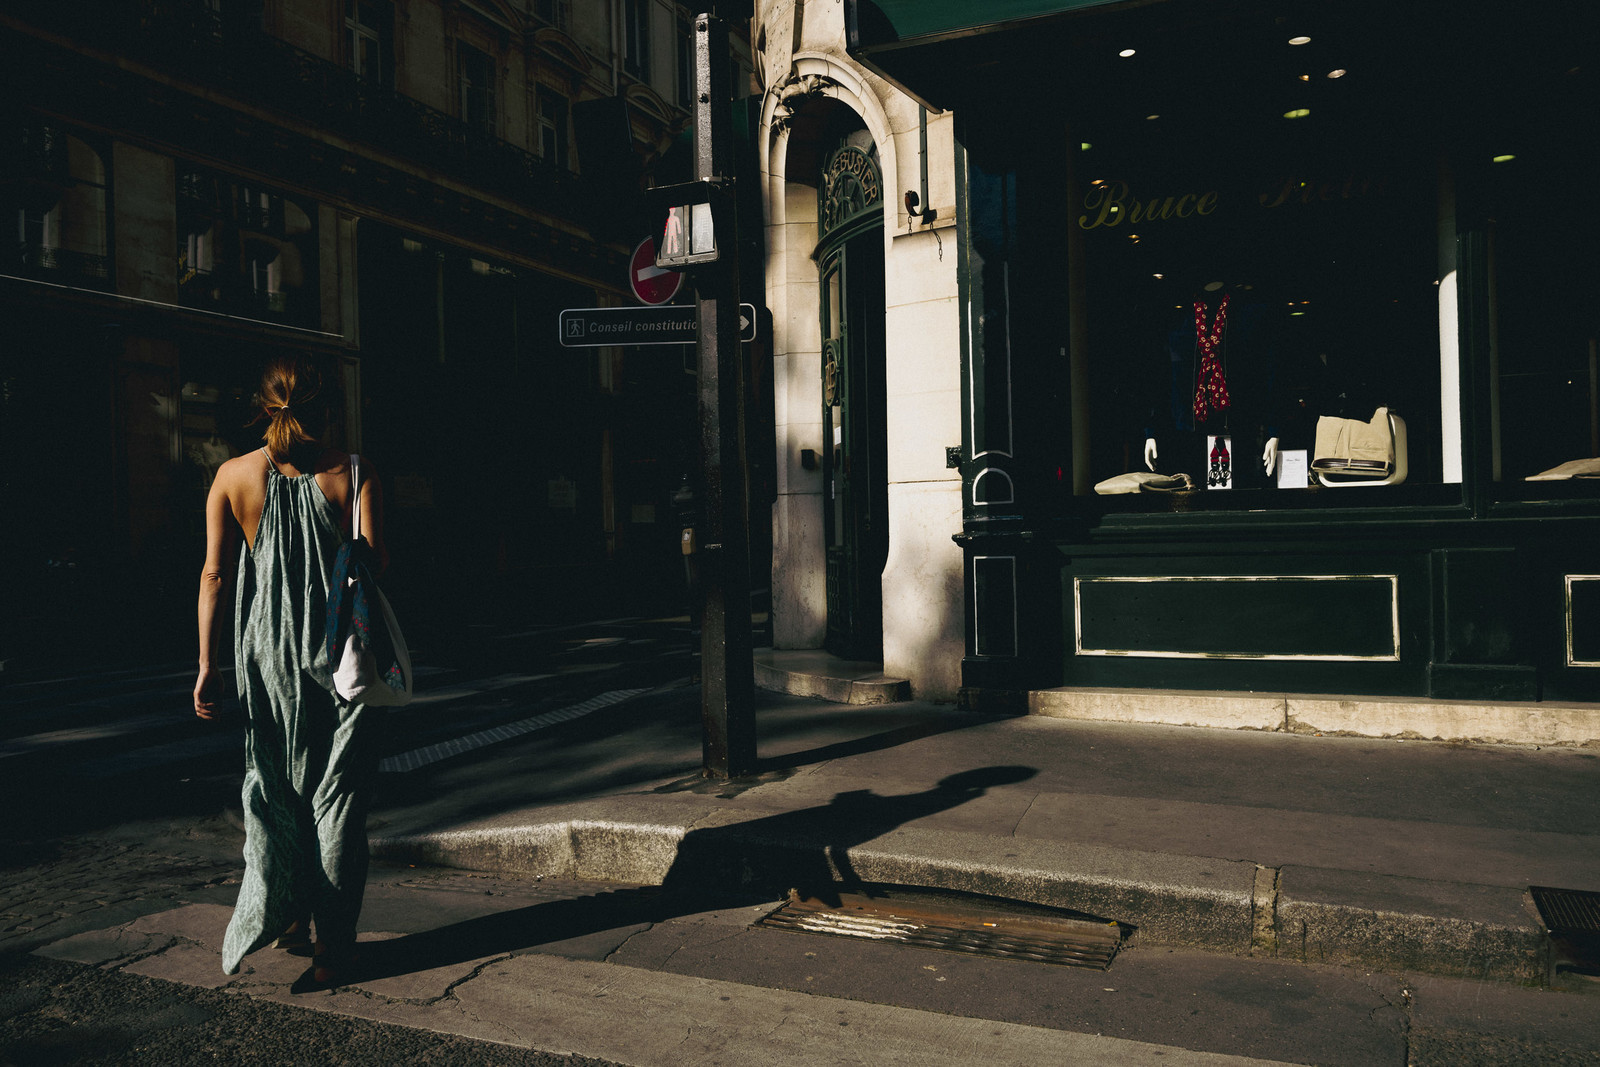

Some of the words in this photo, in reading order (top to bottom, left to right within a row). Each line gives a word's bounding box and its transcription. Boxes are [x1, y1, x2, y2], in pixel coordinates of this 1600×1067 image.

[1078, 180, 1218, 230] Bruce
[589, 320, 632, 333] Conseil
[635, 318, 697, 331] constitutio
